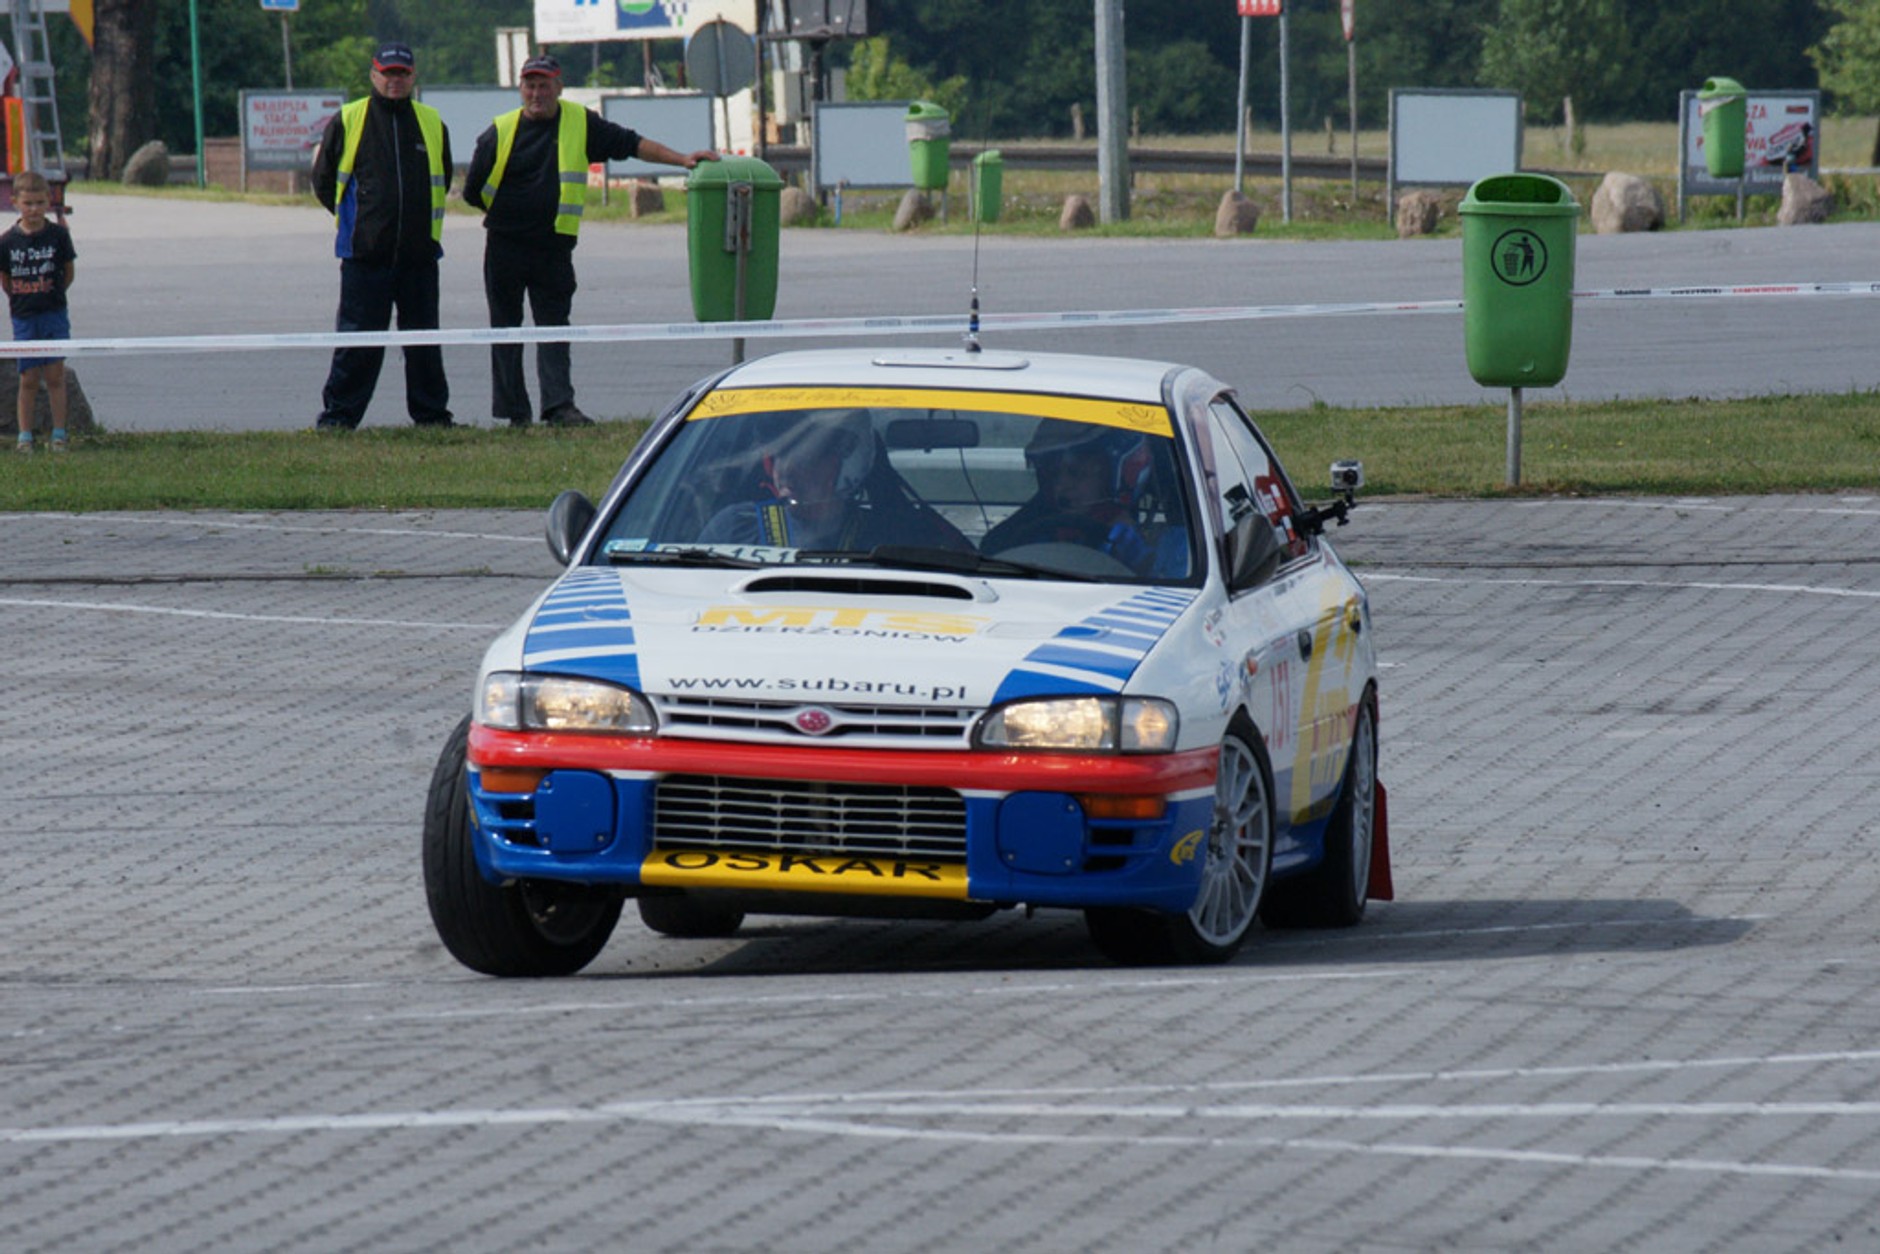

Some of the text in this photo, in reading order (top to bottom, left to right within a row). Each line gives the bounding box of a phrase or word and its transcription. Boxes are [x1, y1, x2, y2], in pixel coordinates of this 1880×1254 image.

[698, 605, 990, 635] MTS
[669, 678, 967, 701] www.subaru.pl
[664, 851, 942, 881] OSKAR
